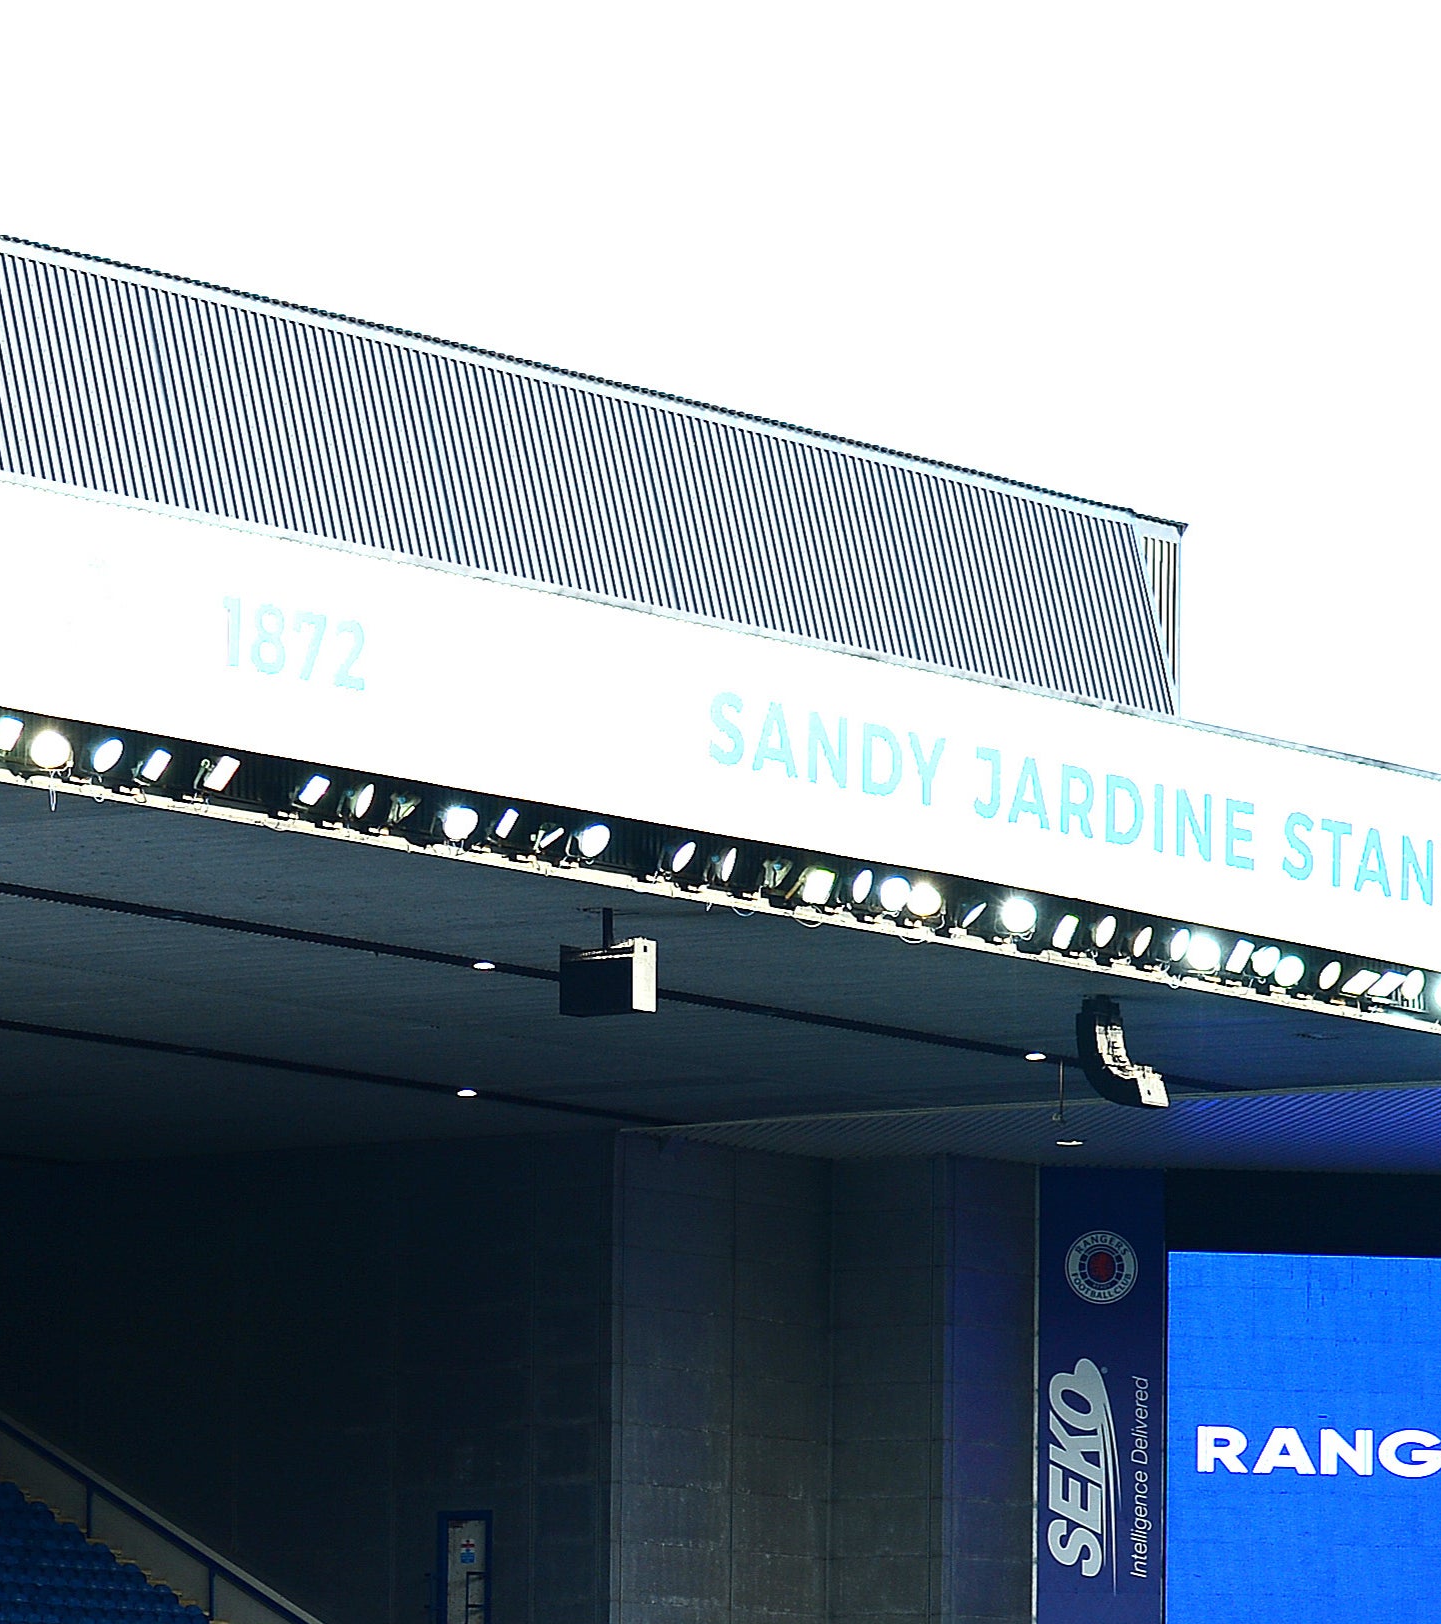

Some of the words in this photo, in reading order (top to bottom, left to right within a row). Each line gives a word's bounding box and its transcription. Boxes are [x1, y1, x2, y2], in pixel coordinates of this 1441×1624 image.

[223, 595, 366, 691] 1872
[709, 692, 947, 807] SANDY
[974, 746, 1256, 870] JARDINE
[1074, 1234, 1129, 1258] RANGERS
[1048, 1357, 1108, 1577] SEKO
[1131, 1376, 1149, 1463] Delivered
[1130, 1466, 1151, 1578] Intelligence
